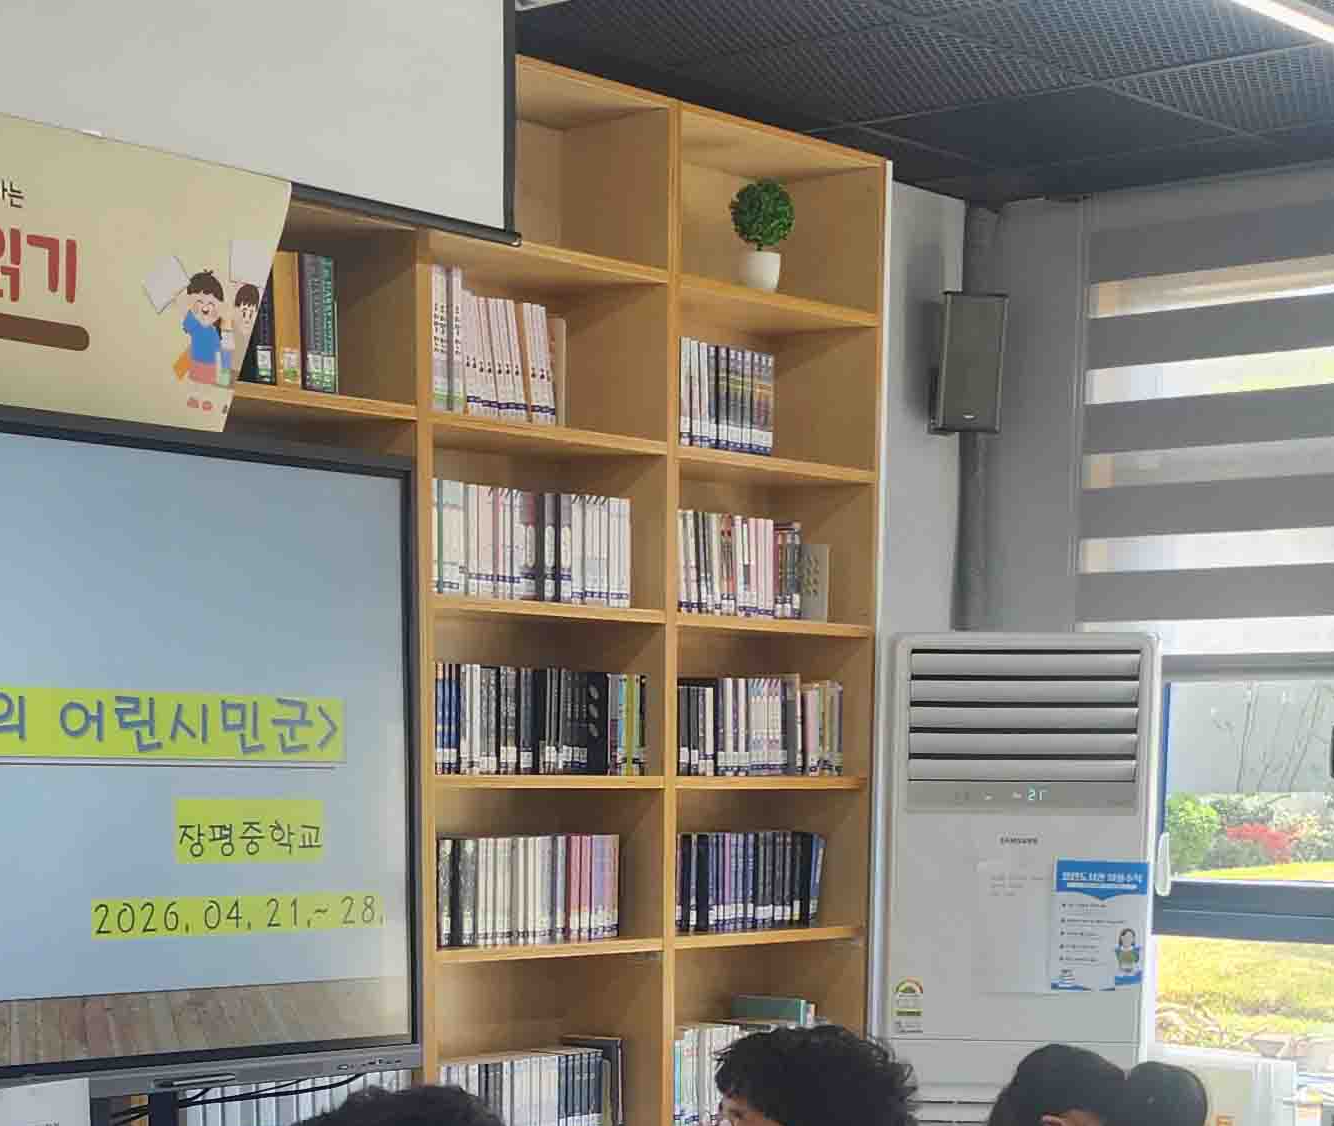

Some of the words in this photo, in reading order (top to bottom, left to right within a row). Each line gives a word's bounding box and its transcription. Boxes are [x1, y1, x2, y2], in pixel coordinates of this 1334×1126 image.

[59, 694, 338, 755] 어린시민군>
[178, 819, 324, 858] 장평중학교
[94, 901, 191, 936] 2026.
[203, 898, 252, 932] 04.
